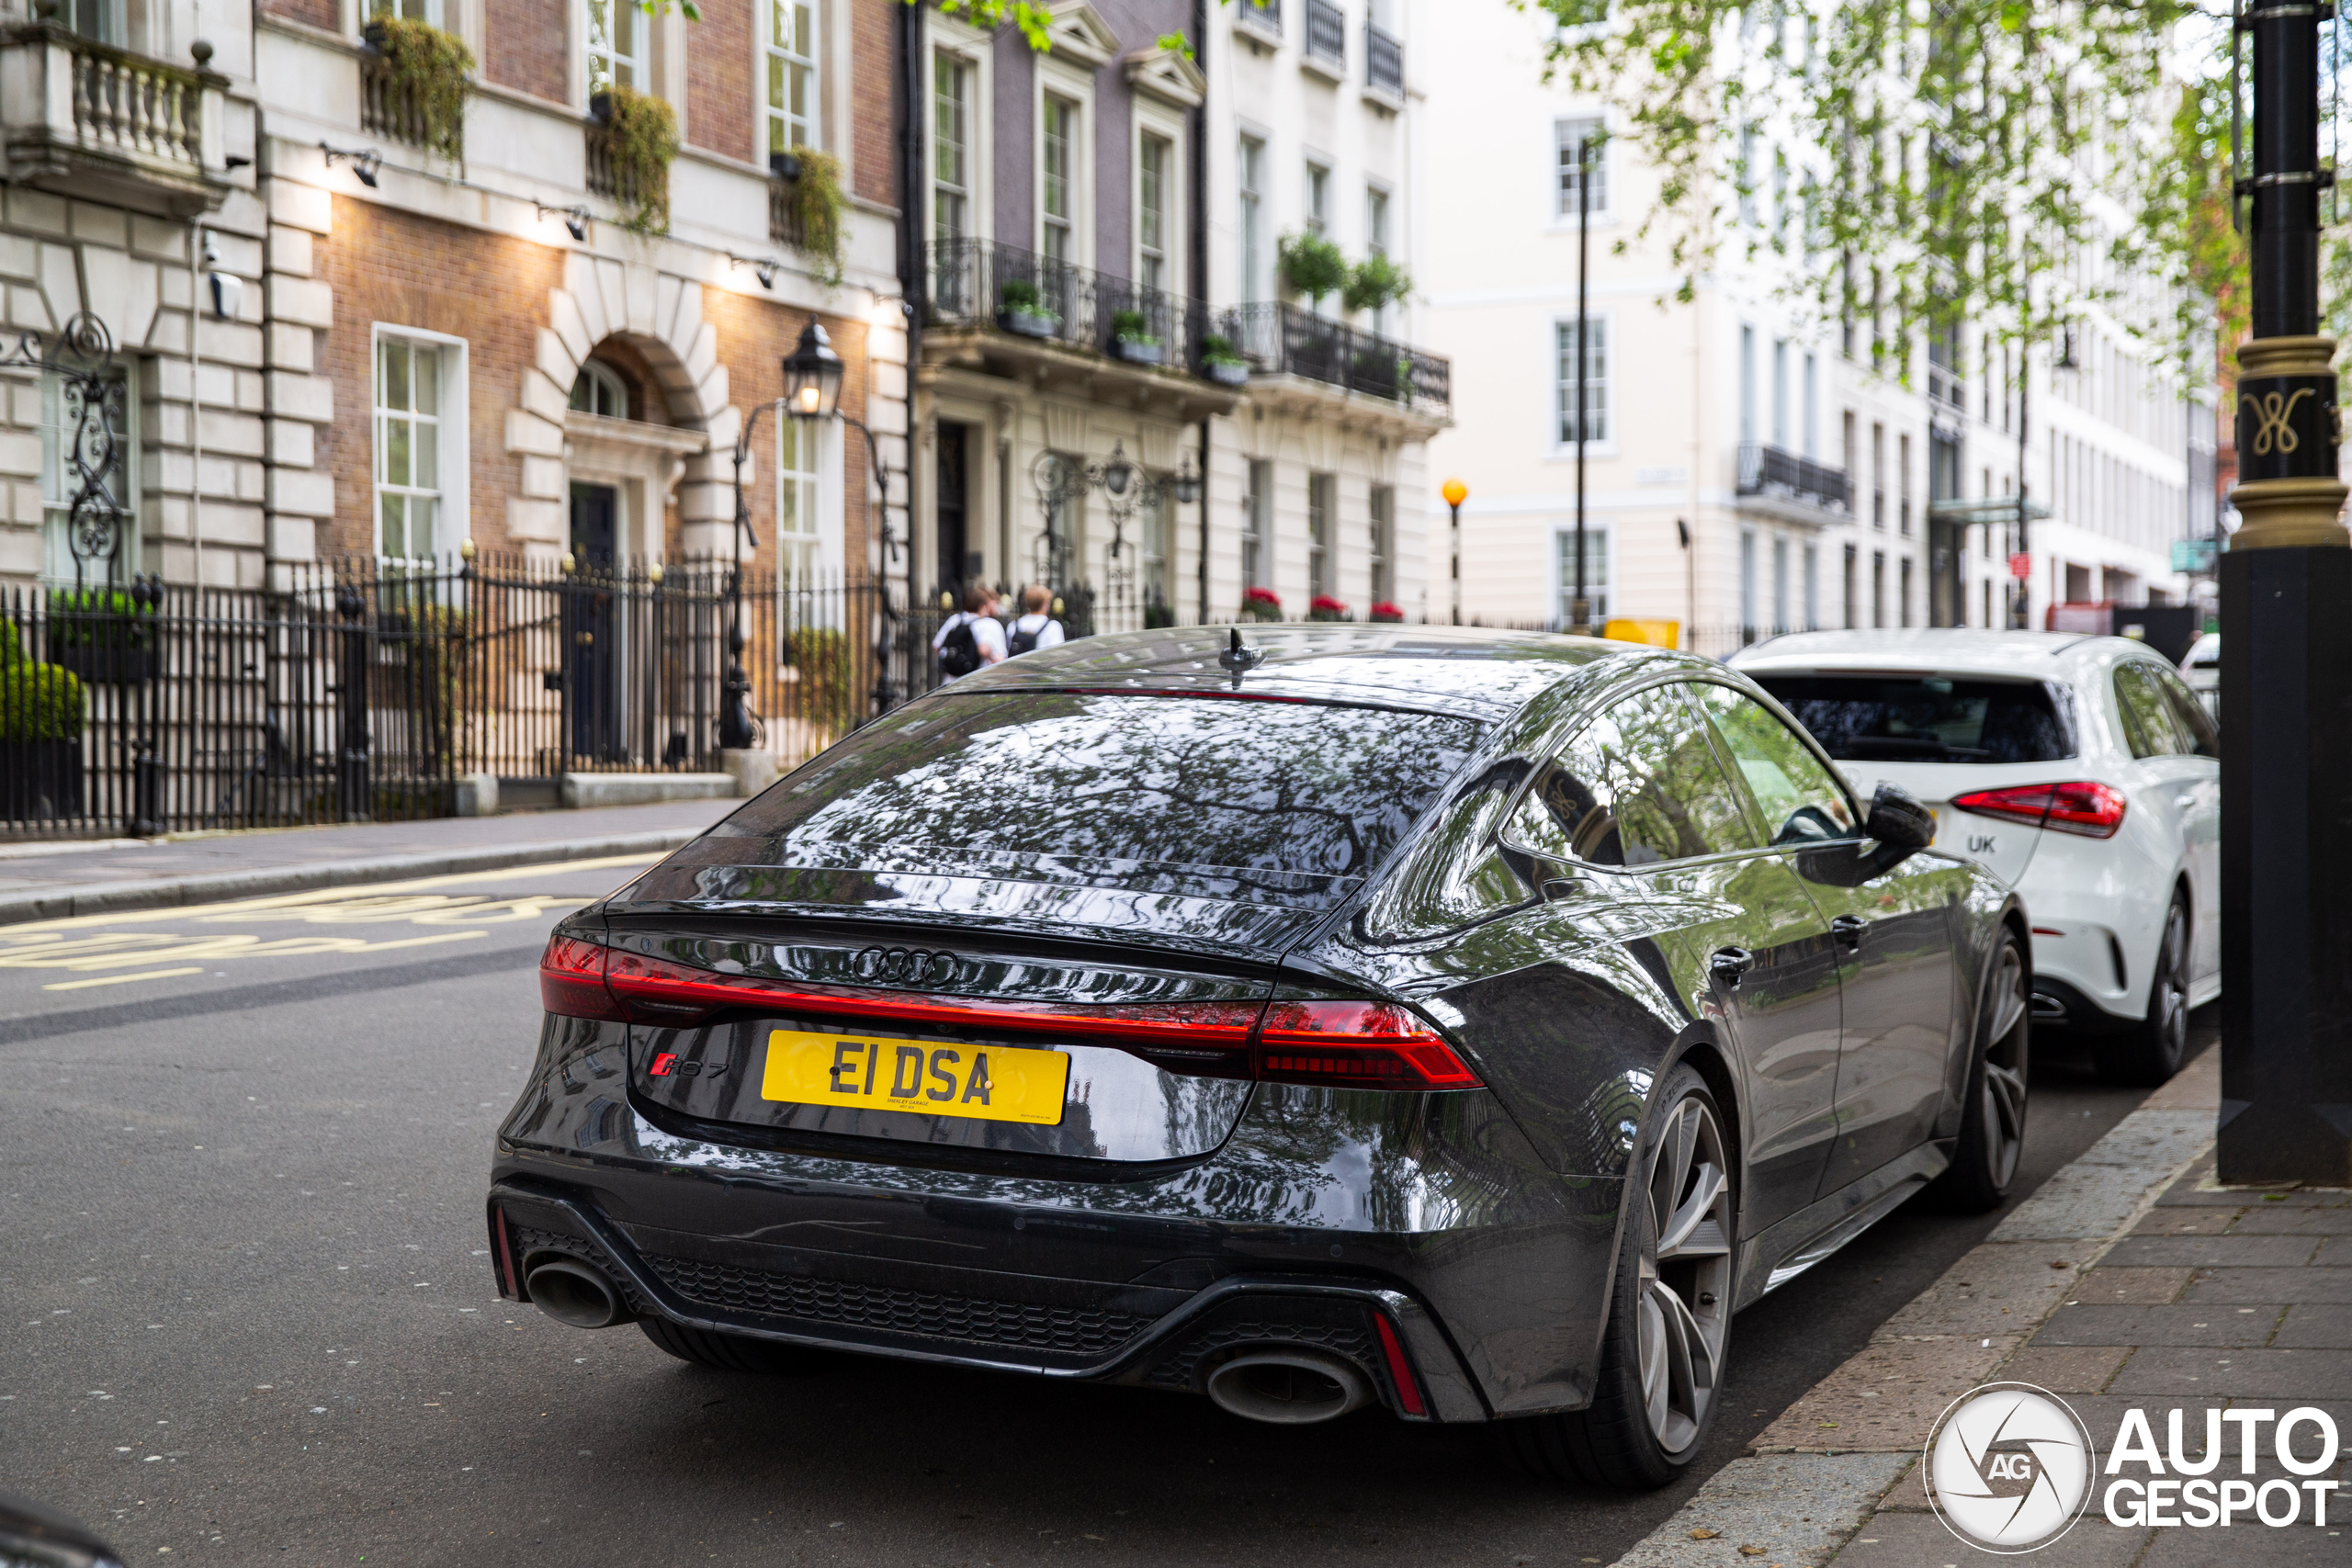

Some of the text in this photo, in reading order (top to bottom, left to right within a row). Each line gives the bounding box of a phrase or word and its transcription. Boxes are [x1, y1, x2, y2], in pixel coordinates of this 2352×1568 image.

[1968, 835, 1996, 852] UK
[0, 931, 368, 971] TOP
[660, 1057, 730, 1078] RS 7
[890, 1045, 991, 1106] DSA
[1661, 1076, 1688, 1113] P ZERO
